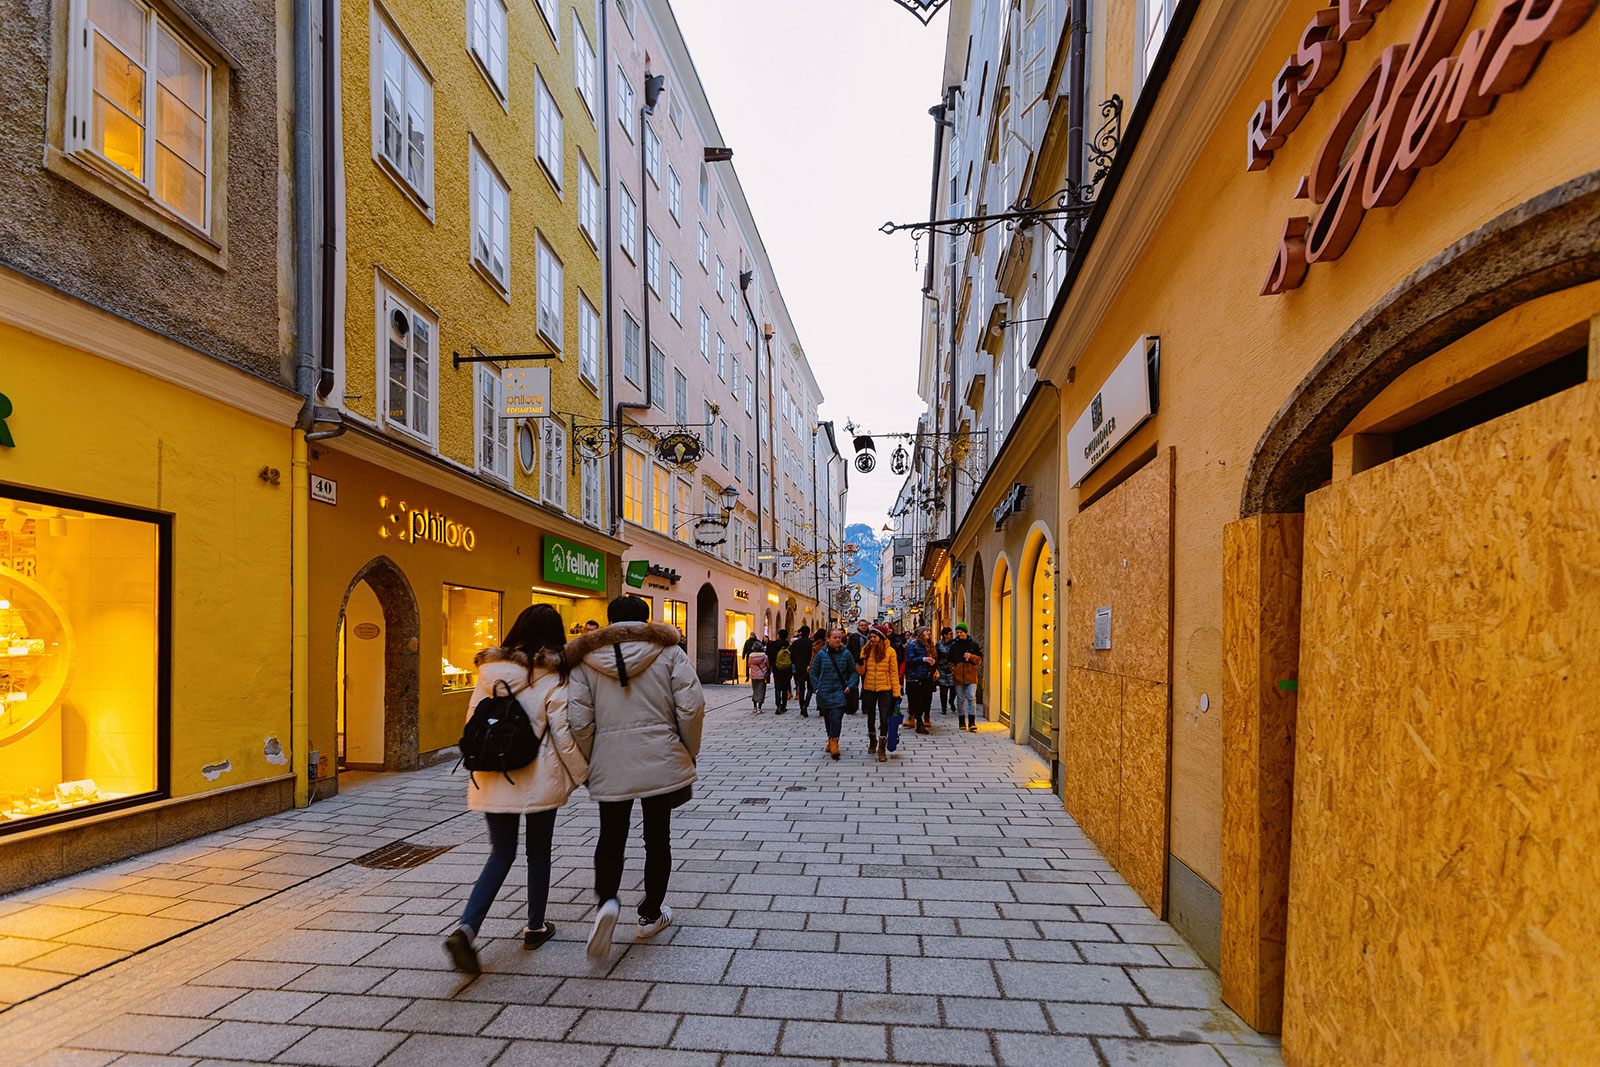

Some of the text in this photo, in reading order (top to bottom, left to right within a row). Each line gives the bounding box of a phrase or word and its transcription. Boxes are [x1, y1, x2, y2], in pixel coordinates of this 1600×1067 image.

[506, 395, 545, 407] philoro
[258, 466, 281, 486] 42
[315, 479, 333, 495] 40
[410, 508, 475, 551] philoro
[566, 550, 599, 579] fellhof
